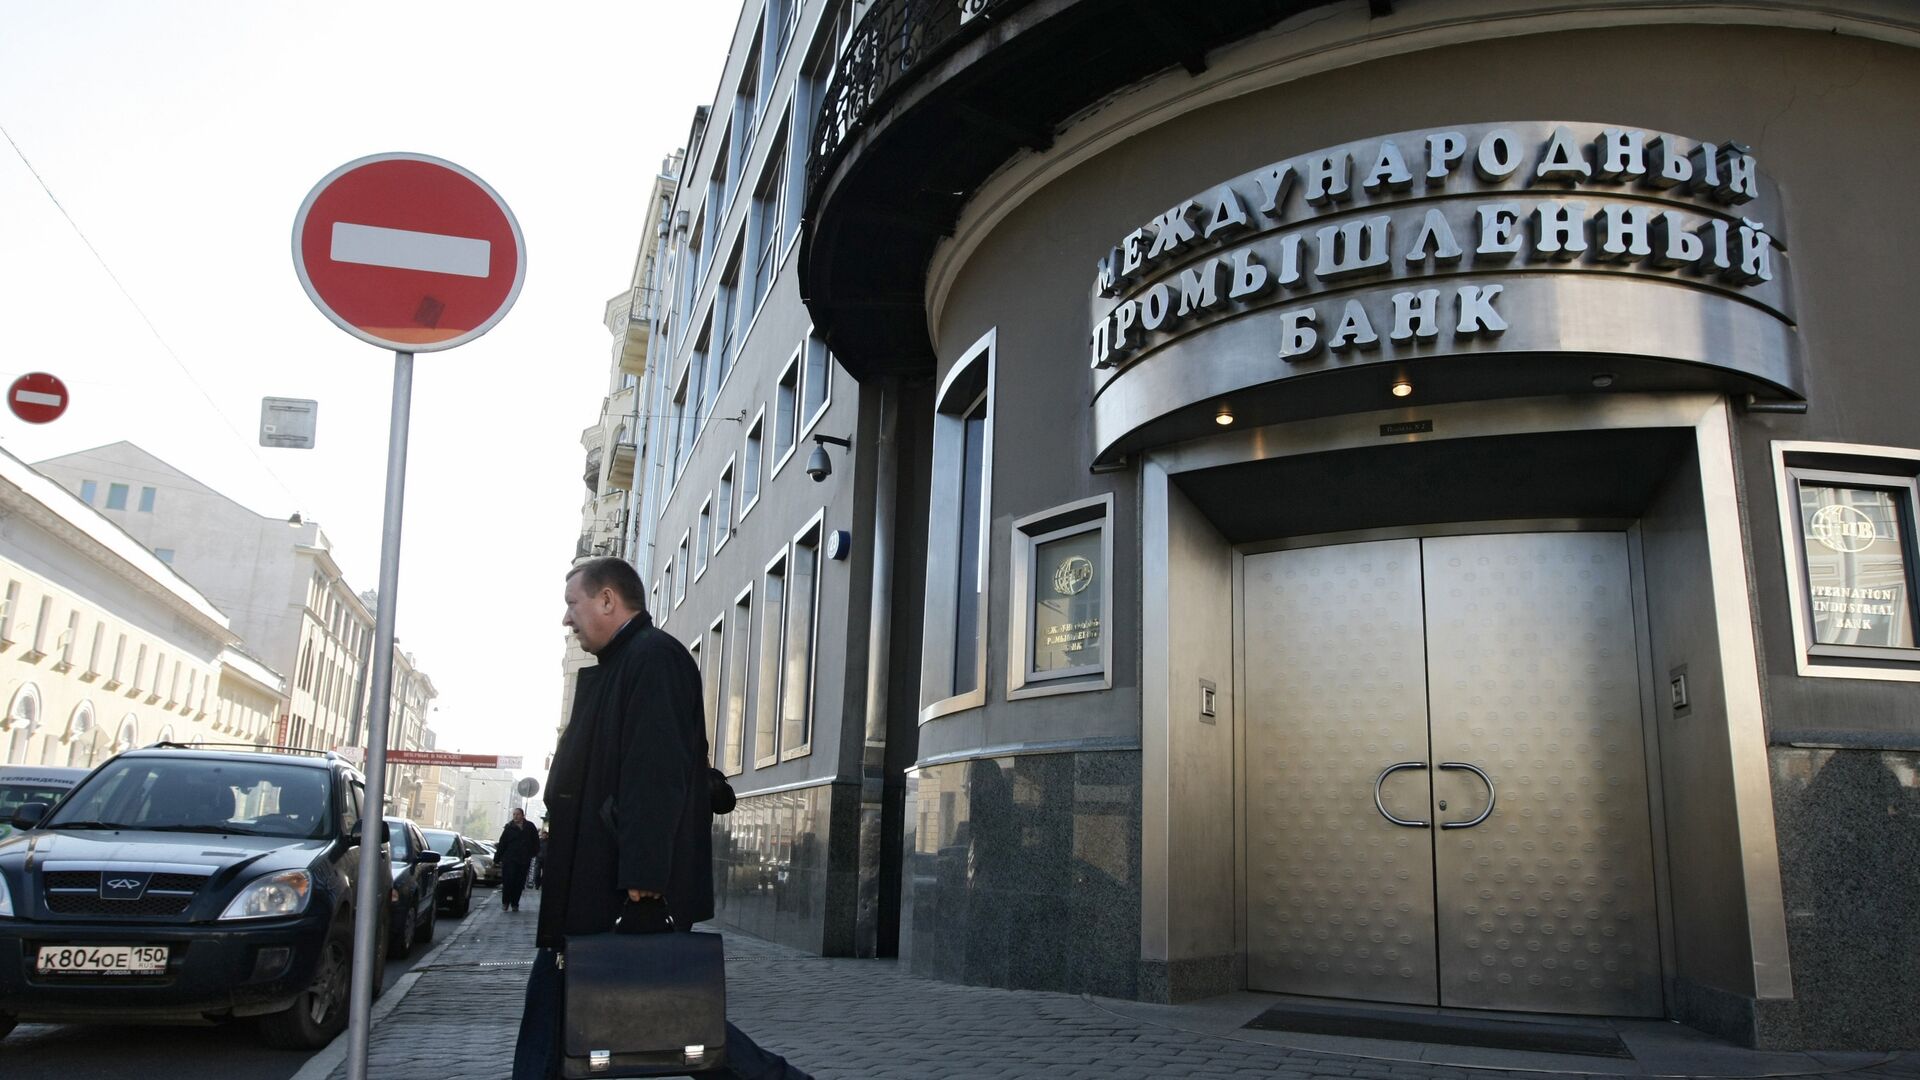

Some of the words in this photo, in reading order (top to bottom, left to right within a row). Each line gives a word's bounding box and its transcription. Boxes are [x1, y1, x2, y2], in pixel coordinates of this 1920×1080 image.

[1097, 126, 1759, 298] МЕЖДУНАРОДНЫЙ
[1090, 200, 1774, 369] ПРОМЫШЛЕННЫЙ
[1278, 284, 1509, 360] БАНК
[1814, 600, 1895, 616] INDUSTRIAL
[134, 948, 164, 963] 150
